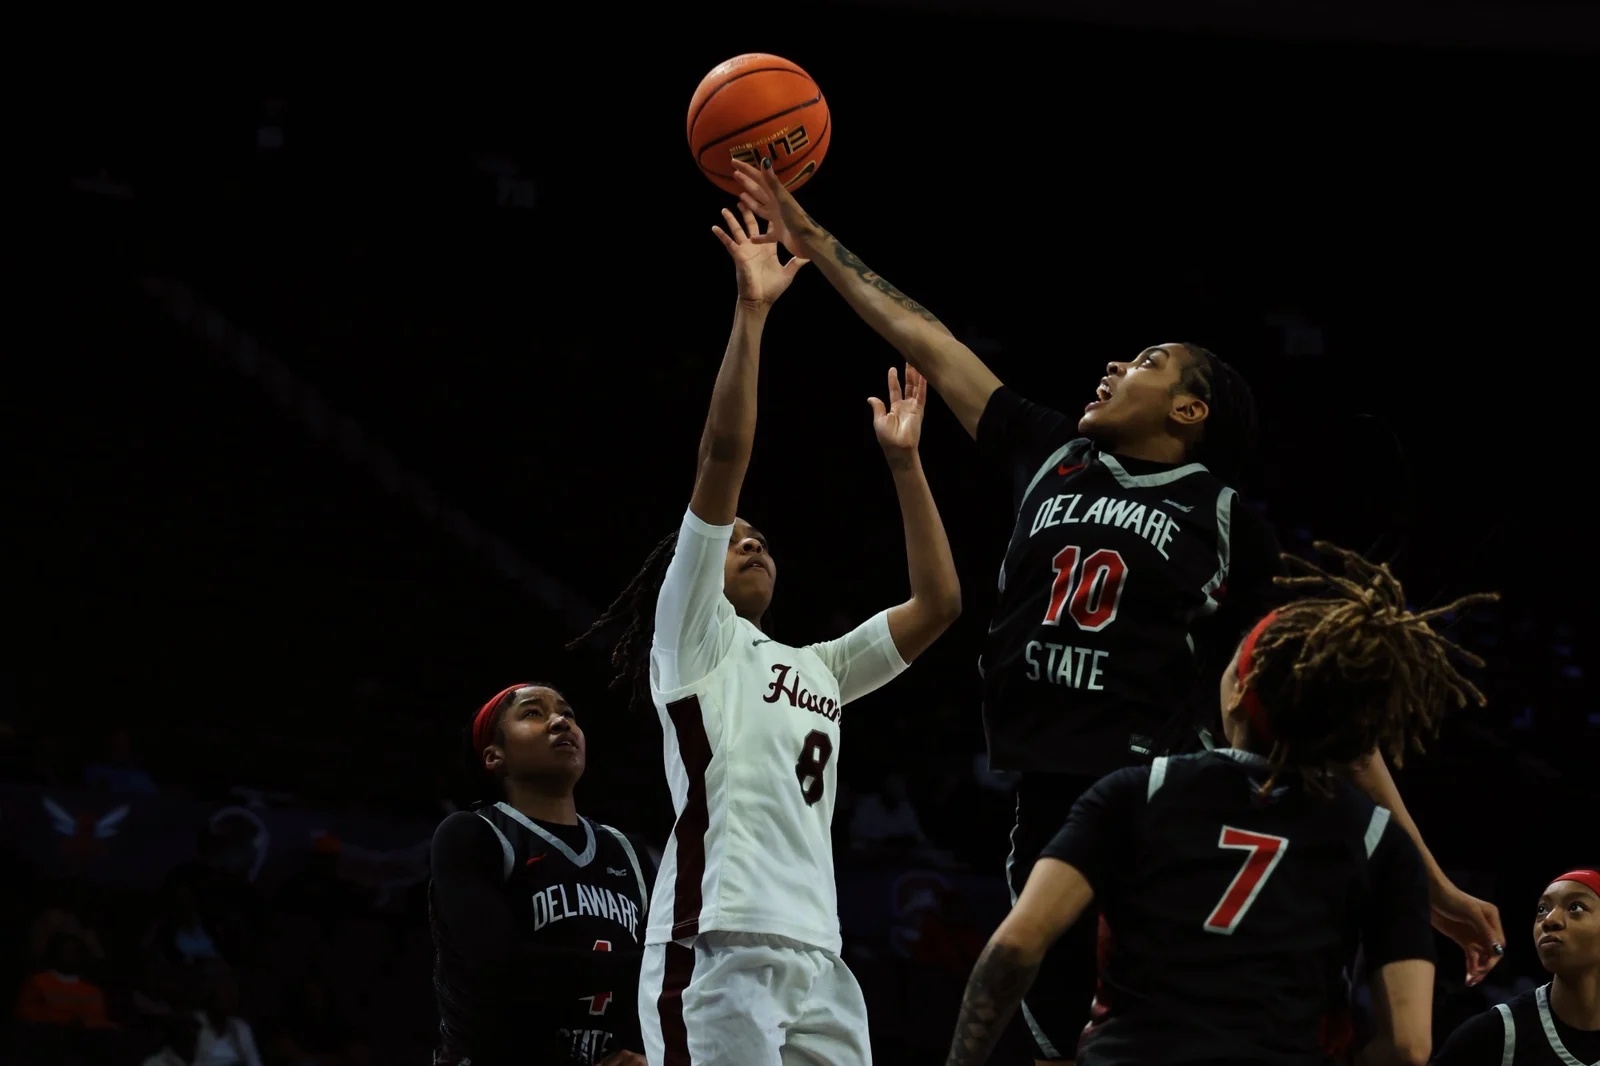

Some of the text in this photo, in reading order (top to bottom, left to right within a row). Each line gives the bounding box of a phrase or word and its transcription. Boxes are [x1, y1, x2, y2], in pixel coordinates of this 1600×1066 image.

[1029, 493, 1181, 560] DELAWARE
[1042, 545, 1129, 632] 10
[1025, 640, 1109, 690] STATE
[795, 729, 833, 807] 8
[531, 882, 639, 944] DELAWARE
[1203, 825, 1289, 935] 7
